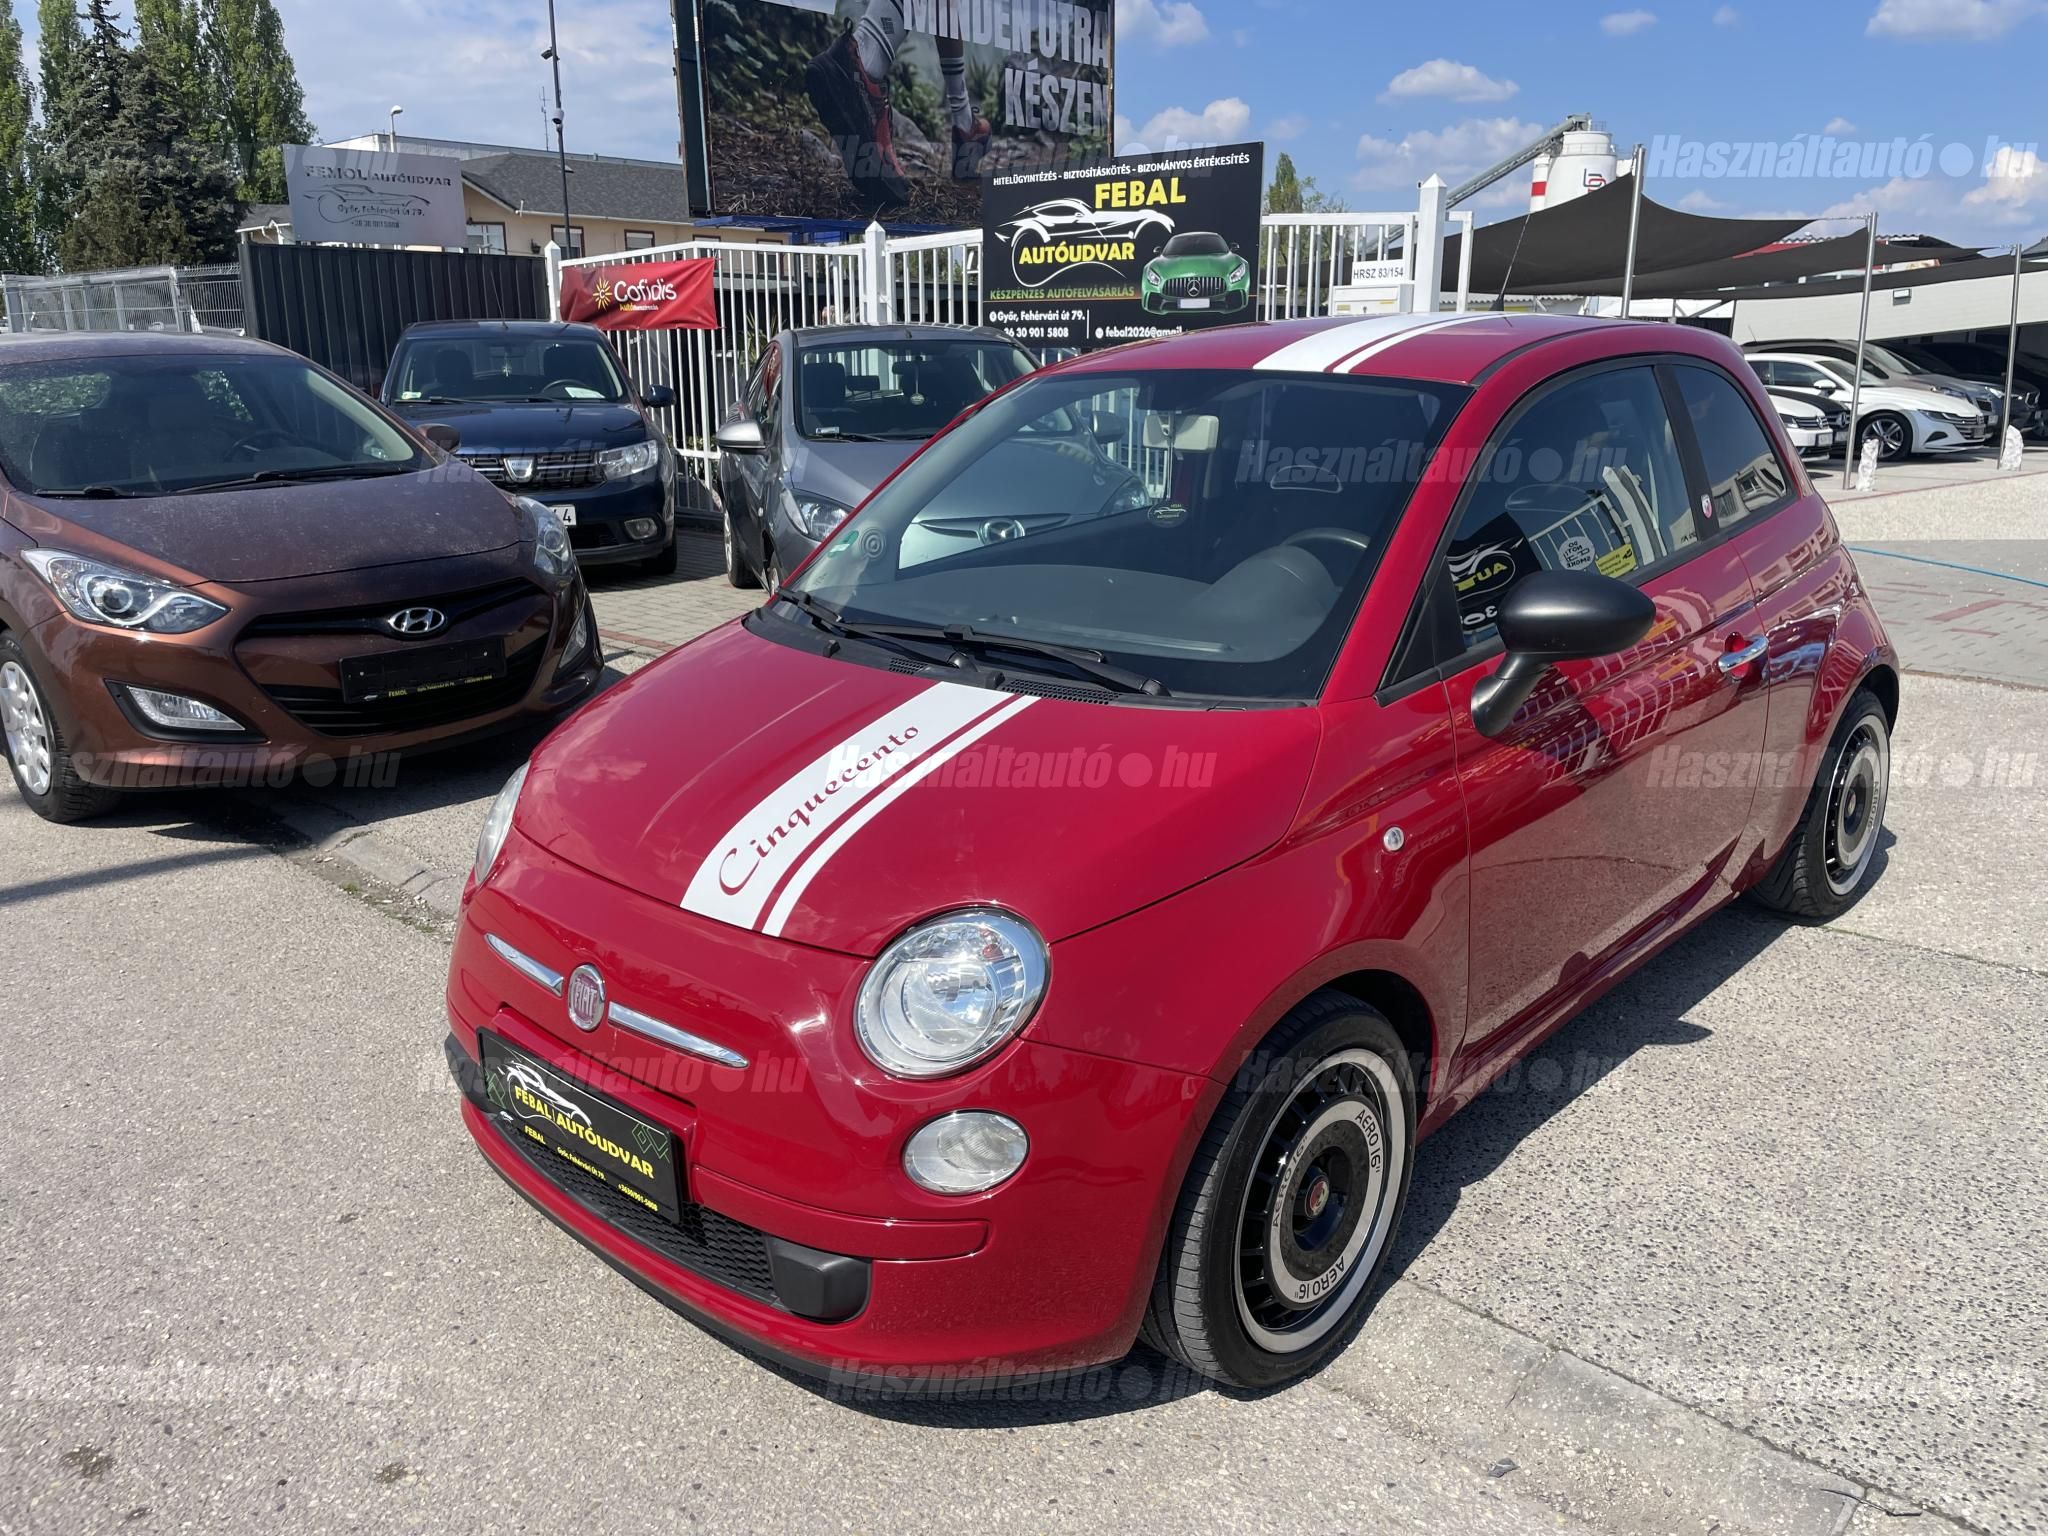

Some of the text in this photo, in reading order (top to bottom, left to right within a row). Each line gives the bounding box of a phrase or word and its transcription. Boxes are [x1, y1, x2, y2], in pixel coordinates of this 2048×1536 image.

[904, 0, 1031, 54] MINDEN
[1004, 58, 1109, 137] KÉSZEN
[993, 171, 1057, 185] HITELÜGYINTÉZÉS
[1064, 164, 1130, 180] BIZTOSÍTÁSKÖTÉS
[1137, 159, 1192, 173] BIZOMÁNYOS
[1193, 152, 1250, 168] ÉRTÉKESÍTÉS
[1095, 177, 1186, 209] FEBAL
[1019, 241, 1135, 265] AUTÓUDVAR
[1353, 267, 1403, 279] HRSZ 83/154
[614, 278, 677, 302] Cofidis
[990, 284, 1135, 300] KÉSZPÉNZES AUTÓFELVÁSÁRLÁS
[998, 309, 1085, 323] Győr, Fehérvári út 79.
[1016, 327, 1027, 338] 30
[1029, 327, 1044, 338] 901
[1047, 327, 1069, 338] 5808
[718, 725, 919, 896] Cinquecento
[574, 981, 597, 1017] FIAT
[514, 1085, 655, 1179] FEBAL AUTÓUDVAR
[524, 1125, 547, 1145] FEBAL
[1354, 1109, 1379, 1146] AERO
[1312, 1255, 1345, 1296] AERO
